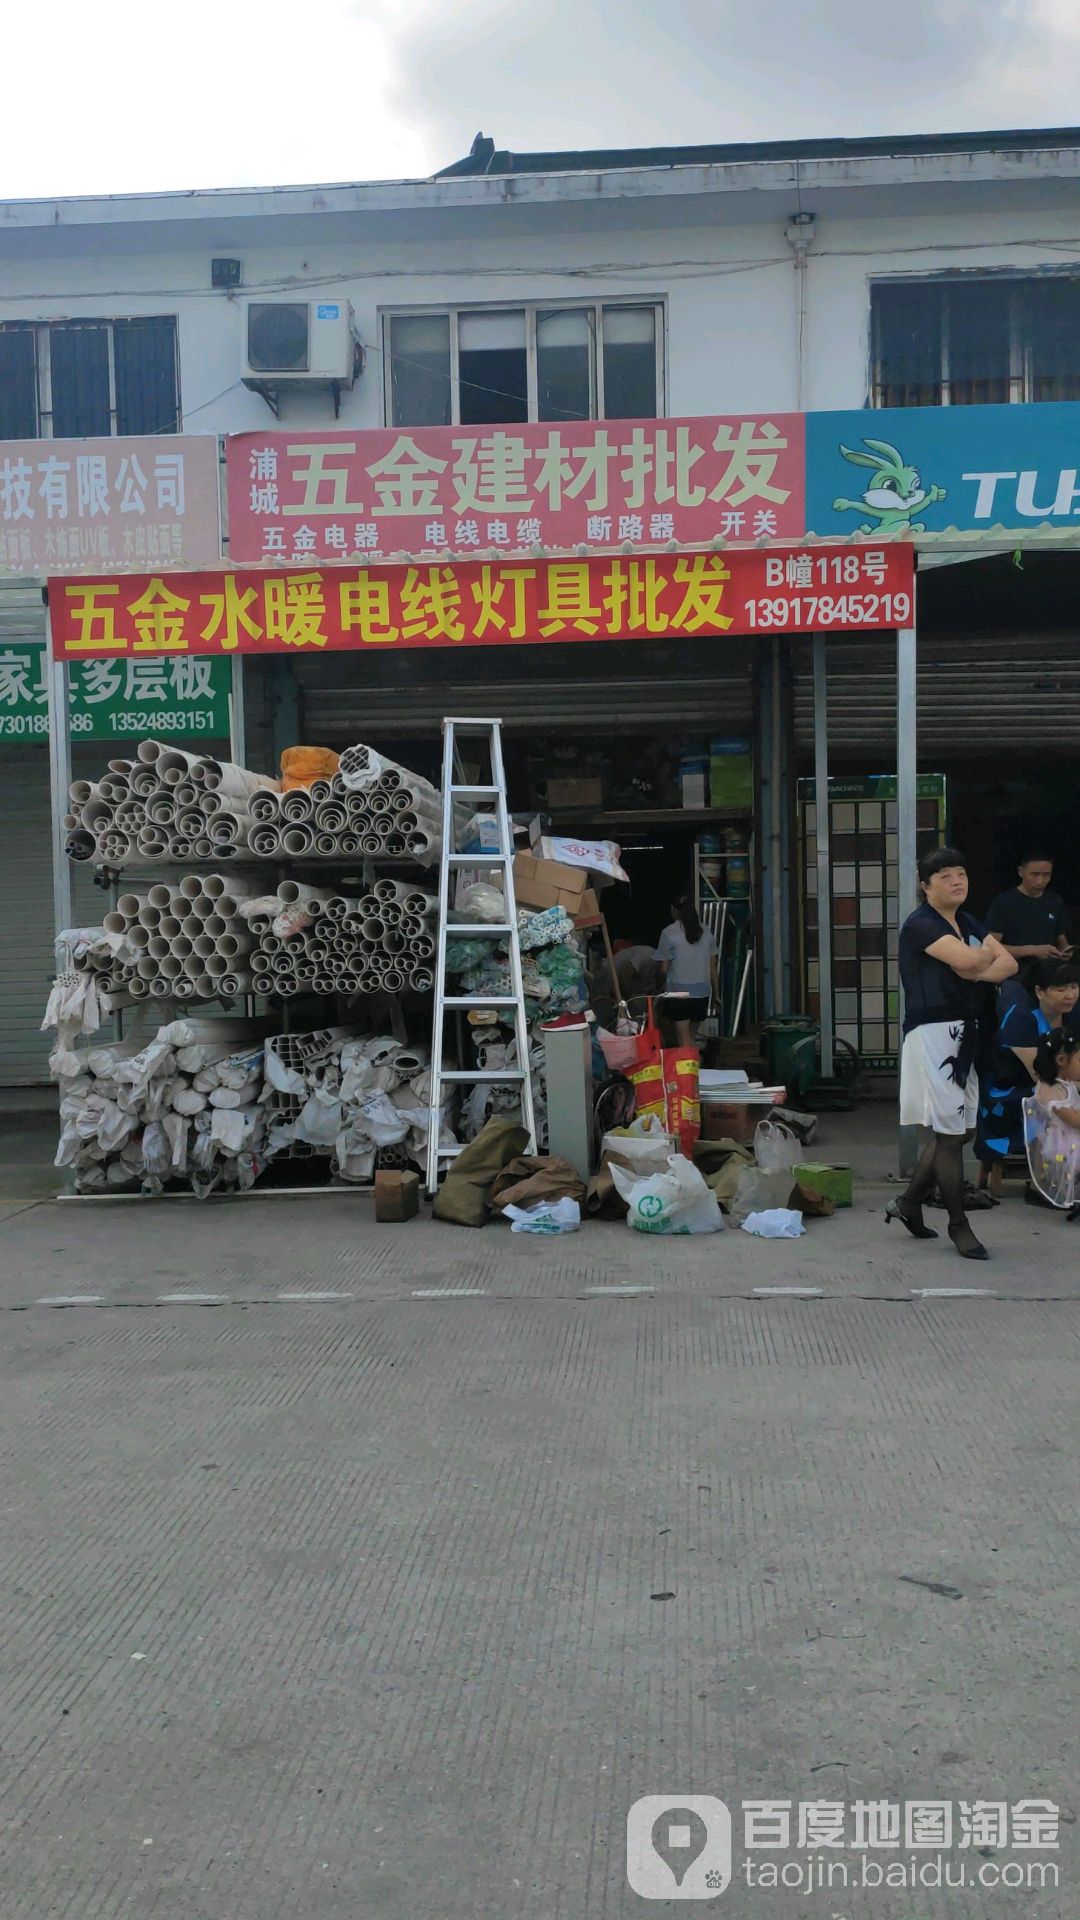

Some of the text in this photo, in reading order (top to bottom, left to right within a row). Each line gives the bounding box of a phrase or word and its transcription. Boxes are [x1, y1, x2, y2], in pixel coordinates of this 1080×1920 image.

[0, 454, 185, 520] 技有限公司
[250, 447, 280, 515] 浦城
[282, 422, 791, 515] 五金建材批发
[262, 509, 778, 550] 五金电器 电线电缆 断路器 开关
[766, 551, 889, 588] B幢118号
[64, 555, 734, 651] 五金水暖电线灯具批发
[744, 592, 910, 628] 13917845219
[109, 711, 214, 731] 13524893151
